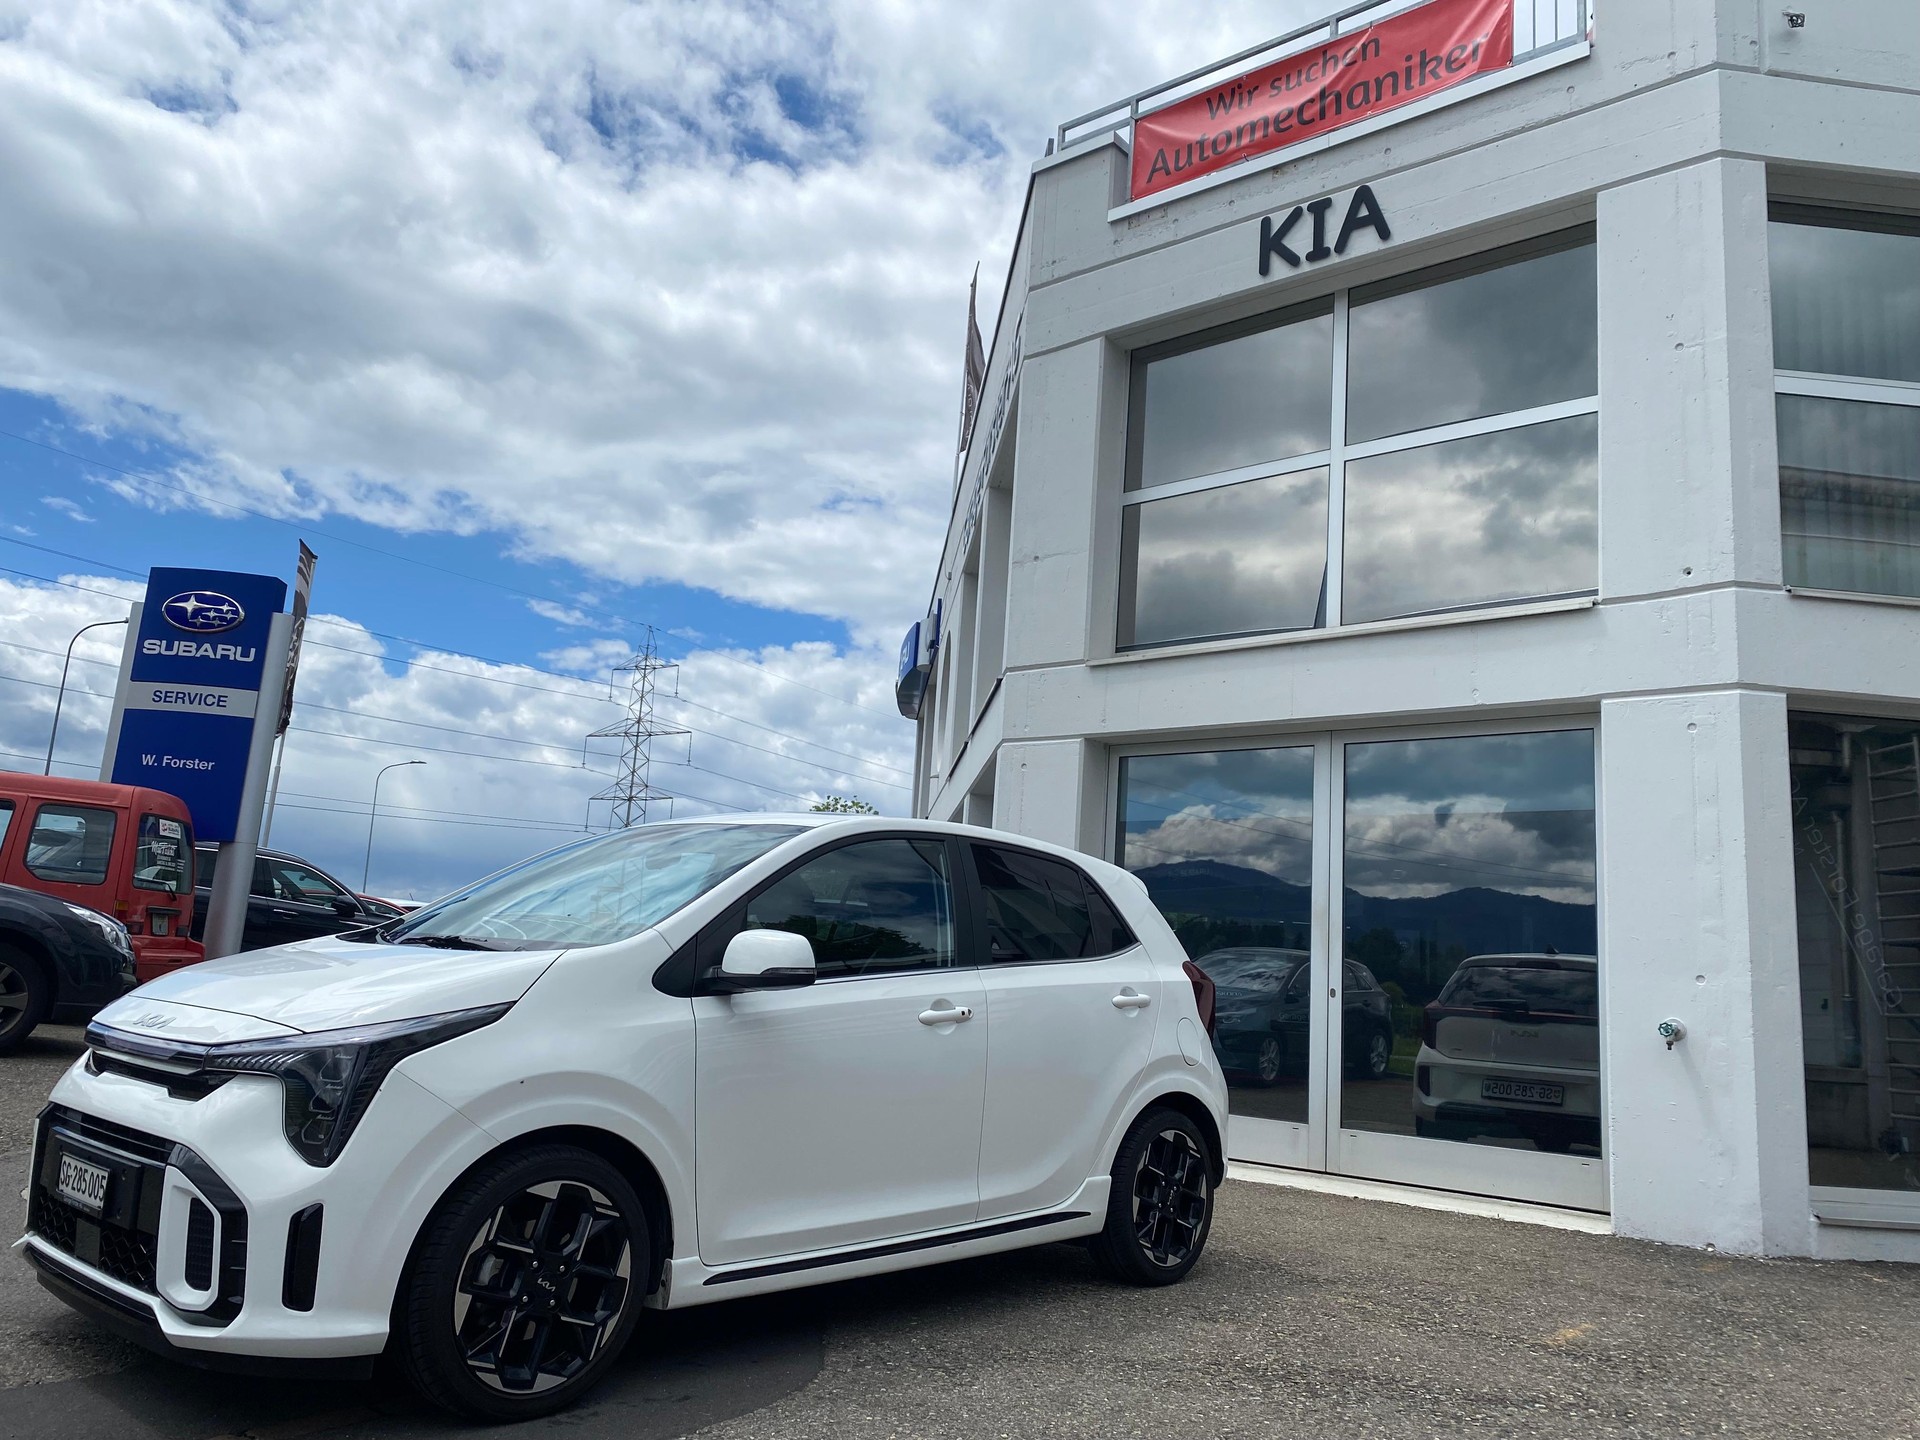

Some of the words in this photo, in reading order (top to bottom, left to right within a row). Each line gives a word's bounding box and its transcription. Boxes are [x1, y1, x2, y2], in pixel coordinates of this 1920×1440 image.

[1206, 84, 1259, 121] Wir
[1269, 36, 1380, 98] suchen
[1146, 32, 1489, 184] Automechaniker
[1258, 184, 1391, 276] KIA
[142, 639, 256, 662] SUBARU
[152, 689, 228, 708] SERVICE
[141, 754, 159, 767] W.
[162, 754, 215, 771] Forster
